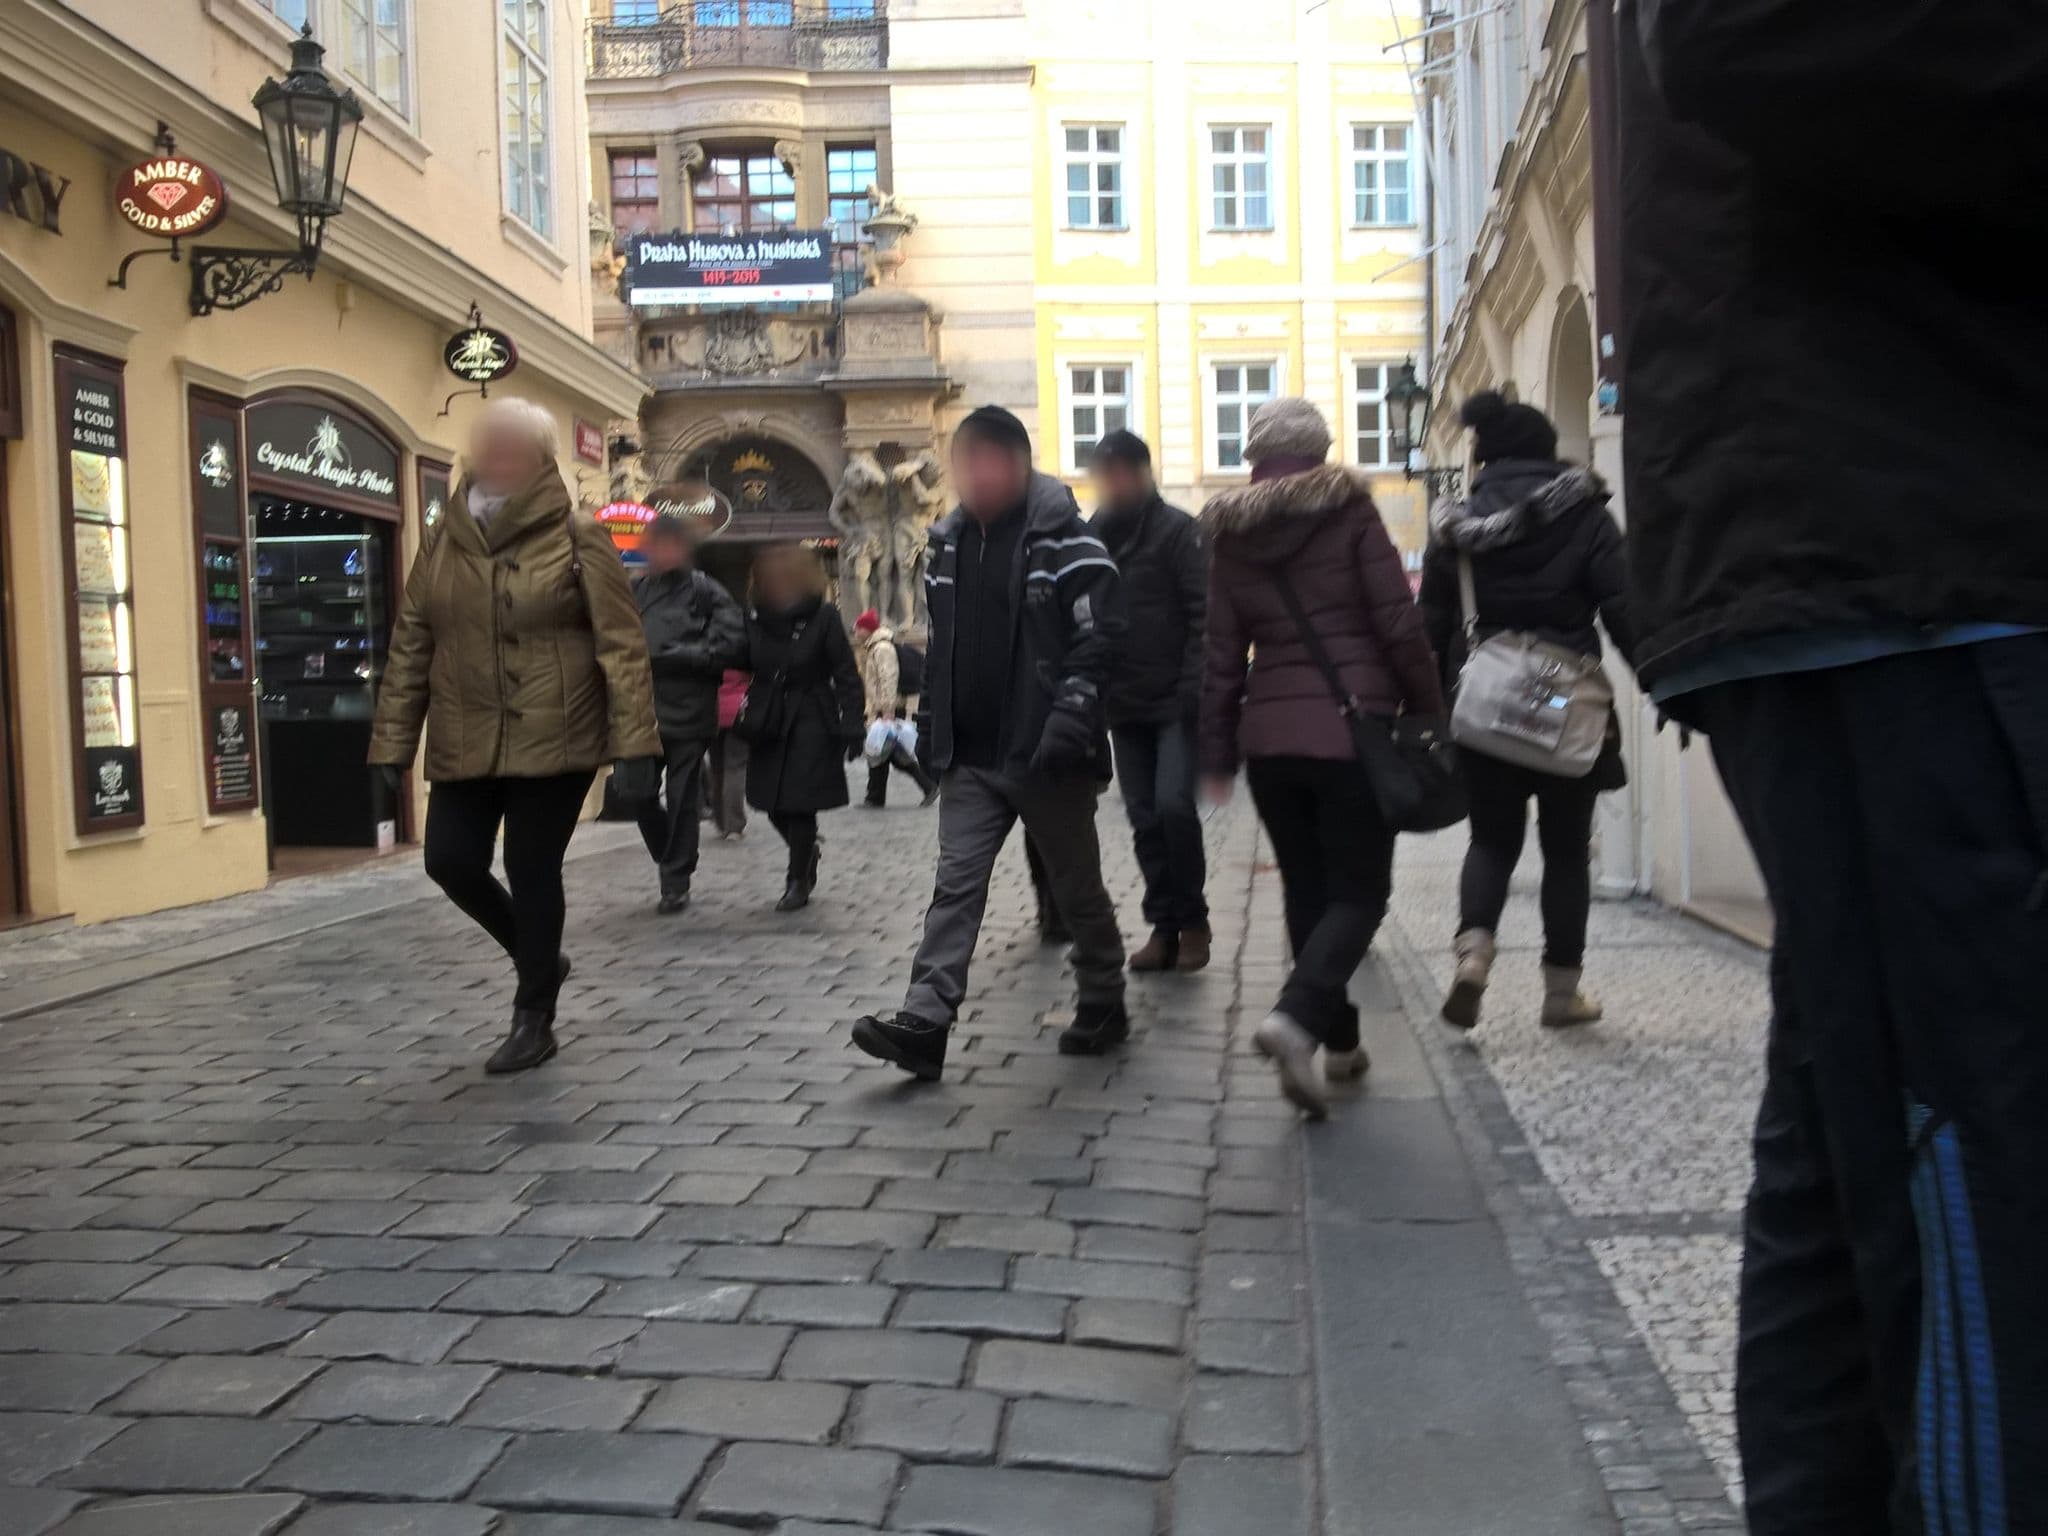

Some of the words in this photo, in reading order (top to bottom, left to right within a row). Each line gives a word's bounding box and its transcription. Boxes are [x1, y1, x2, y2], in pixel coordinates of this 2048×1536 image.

[133, 160, 202, 187] AMBER
[121, 198, 159, 229] GOLD
[159, 216, 172, 231] &
[173, 195, 216, 230] SILVER
[639, 241, 687, 265] Praha
[688, 239, 745, 262] Husova
[75, 388, 111, 409] AMBER
[73, 407, 83, 421] &
[83, 410, 114, 429] GOLD
[73, 426, 83, 441] &
[83, 429, 116, 449] SILVER
[257, 442, 314, 474] Crystal
[312, 459, 358, 488] Magic
[356, 469, 394, 495] Photo
